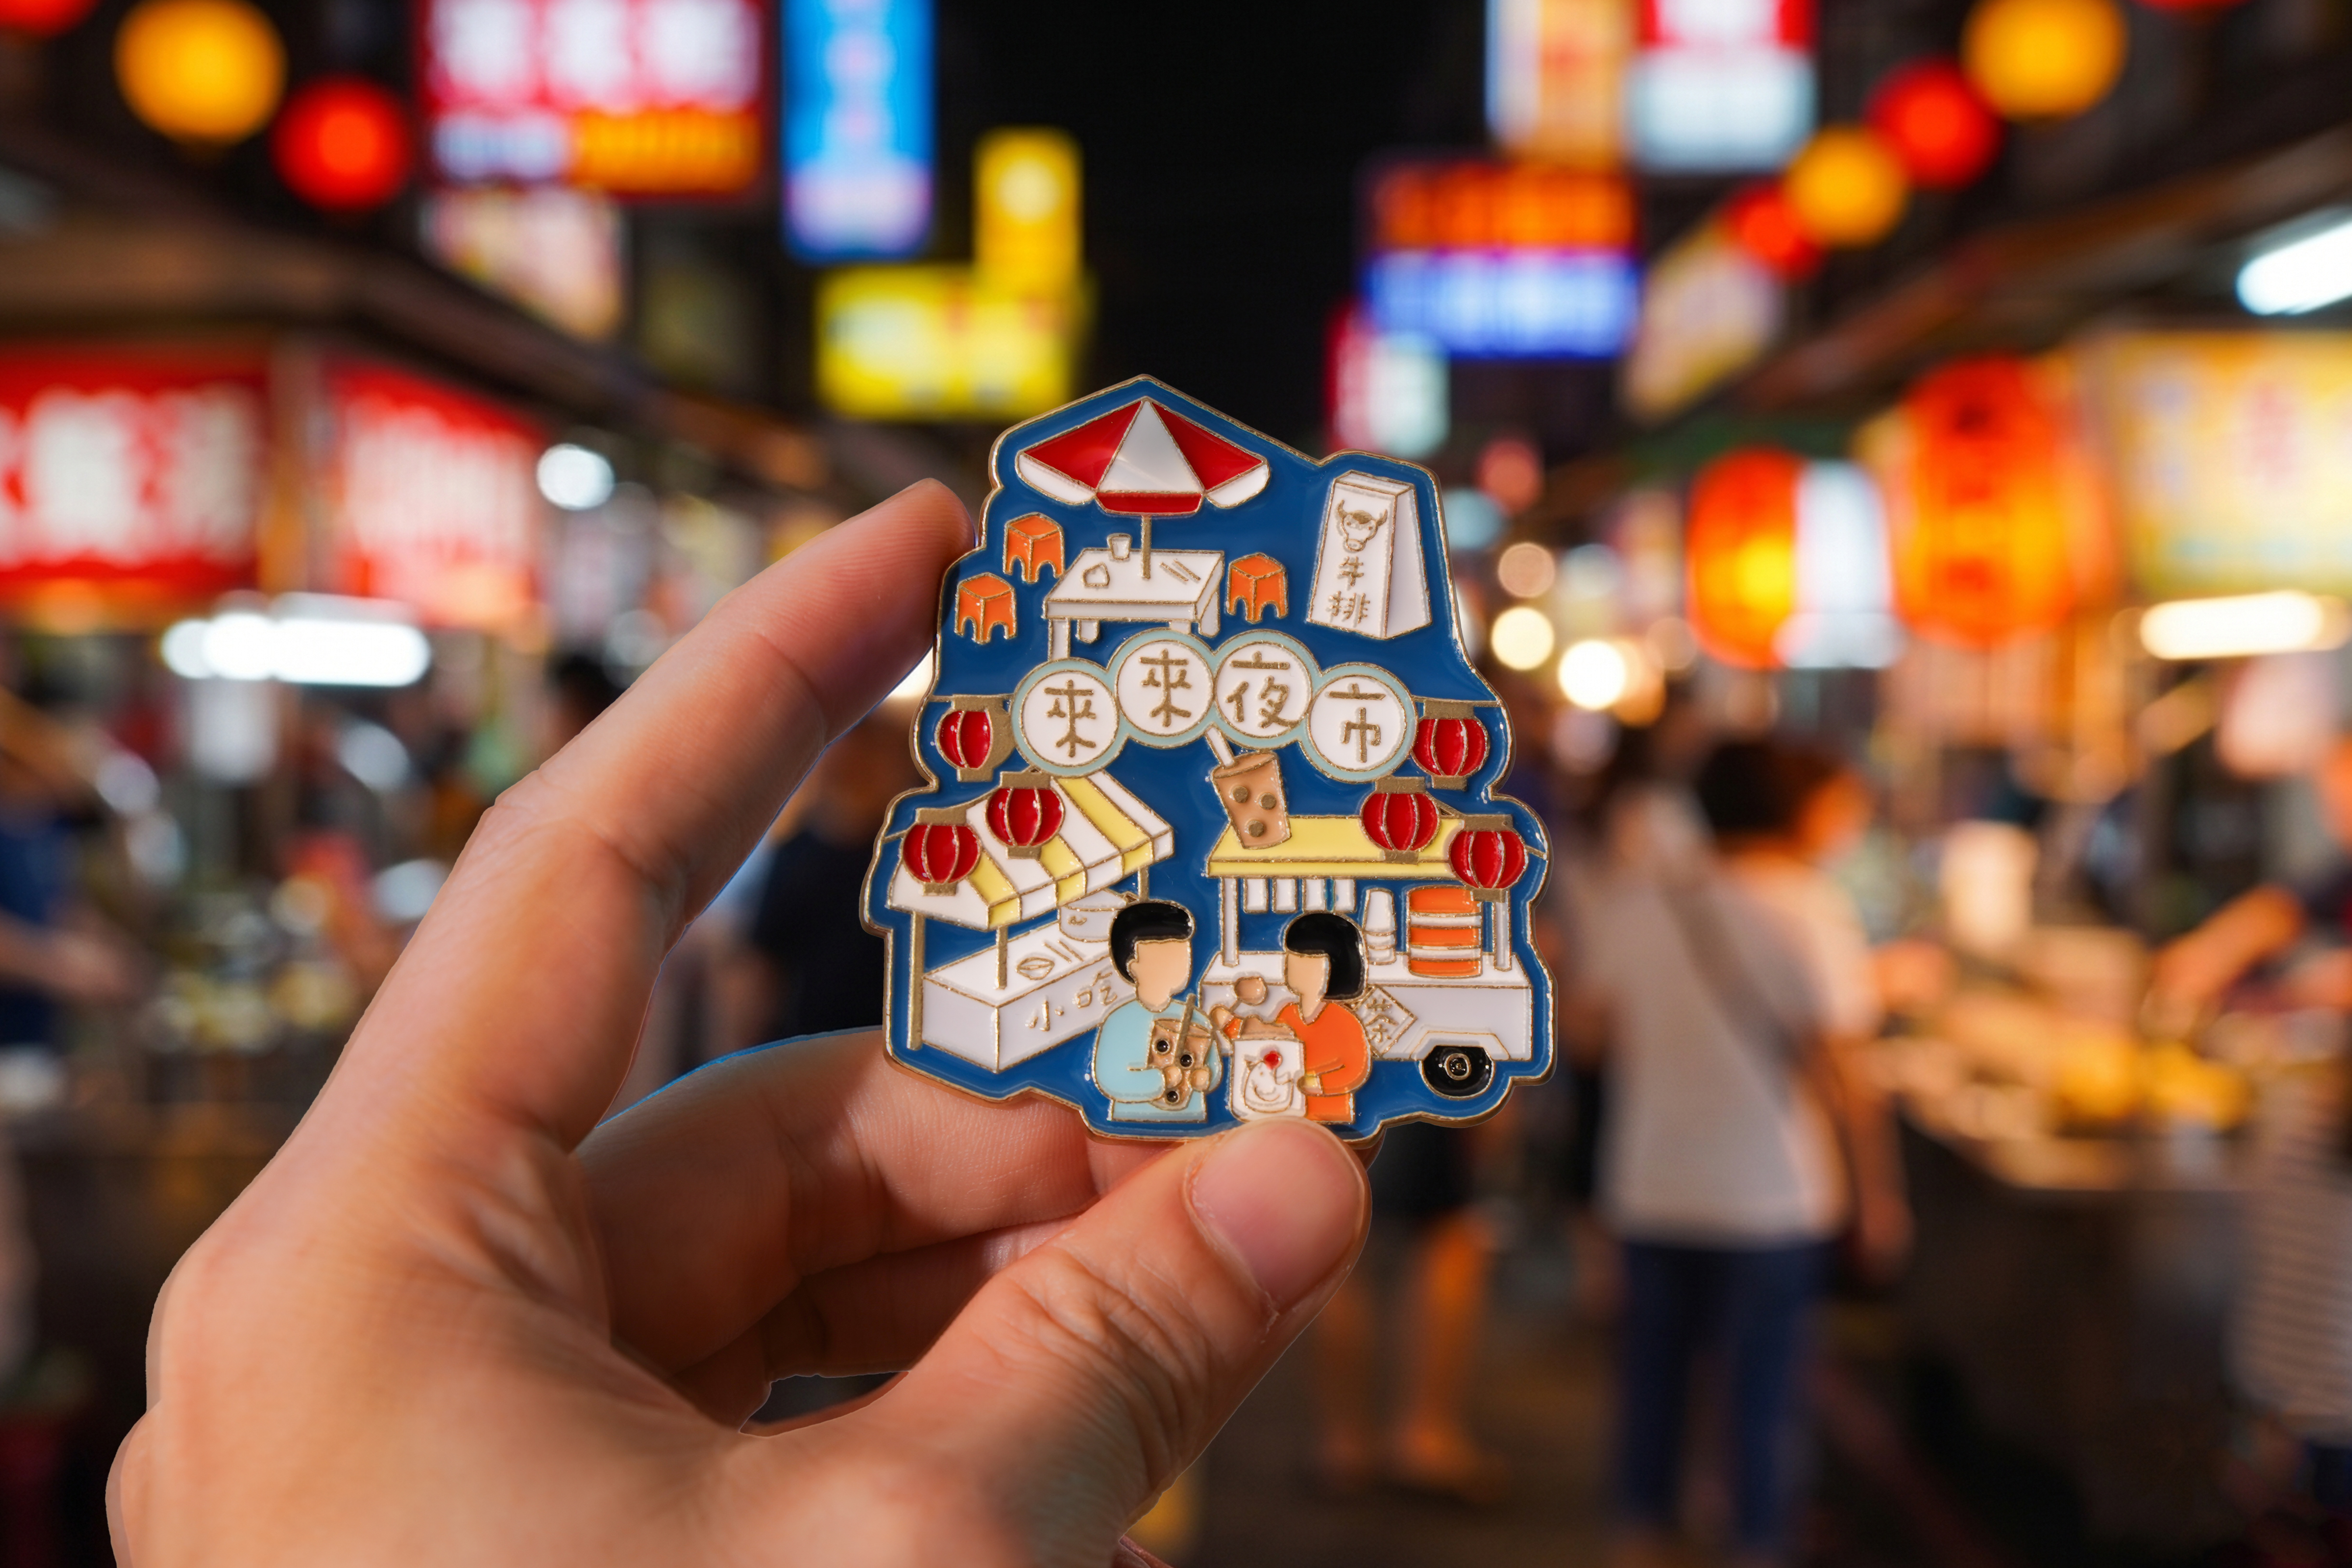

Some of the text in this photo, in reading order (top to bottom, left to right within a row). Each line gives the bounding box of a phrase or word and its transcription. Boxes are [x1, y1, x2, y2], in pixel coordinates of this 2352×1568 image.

[1329, 556, 1370, 624] 牛排
[1044, 648, 1386, 763] 來來夜市
[1025, 971, 1118, 1032] 小吃
[1364, 998, 1400, 1043] 茶
